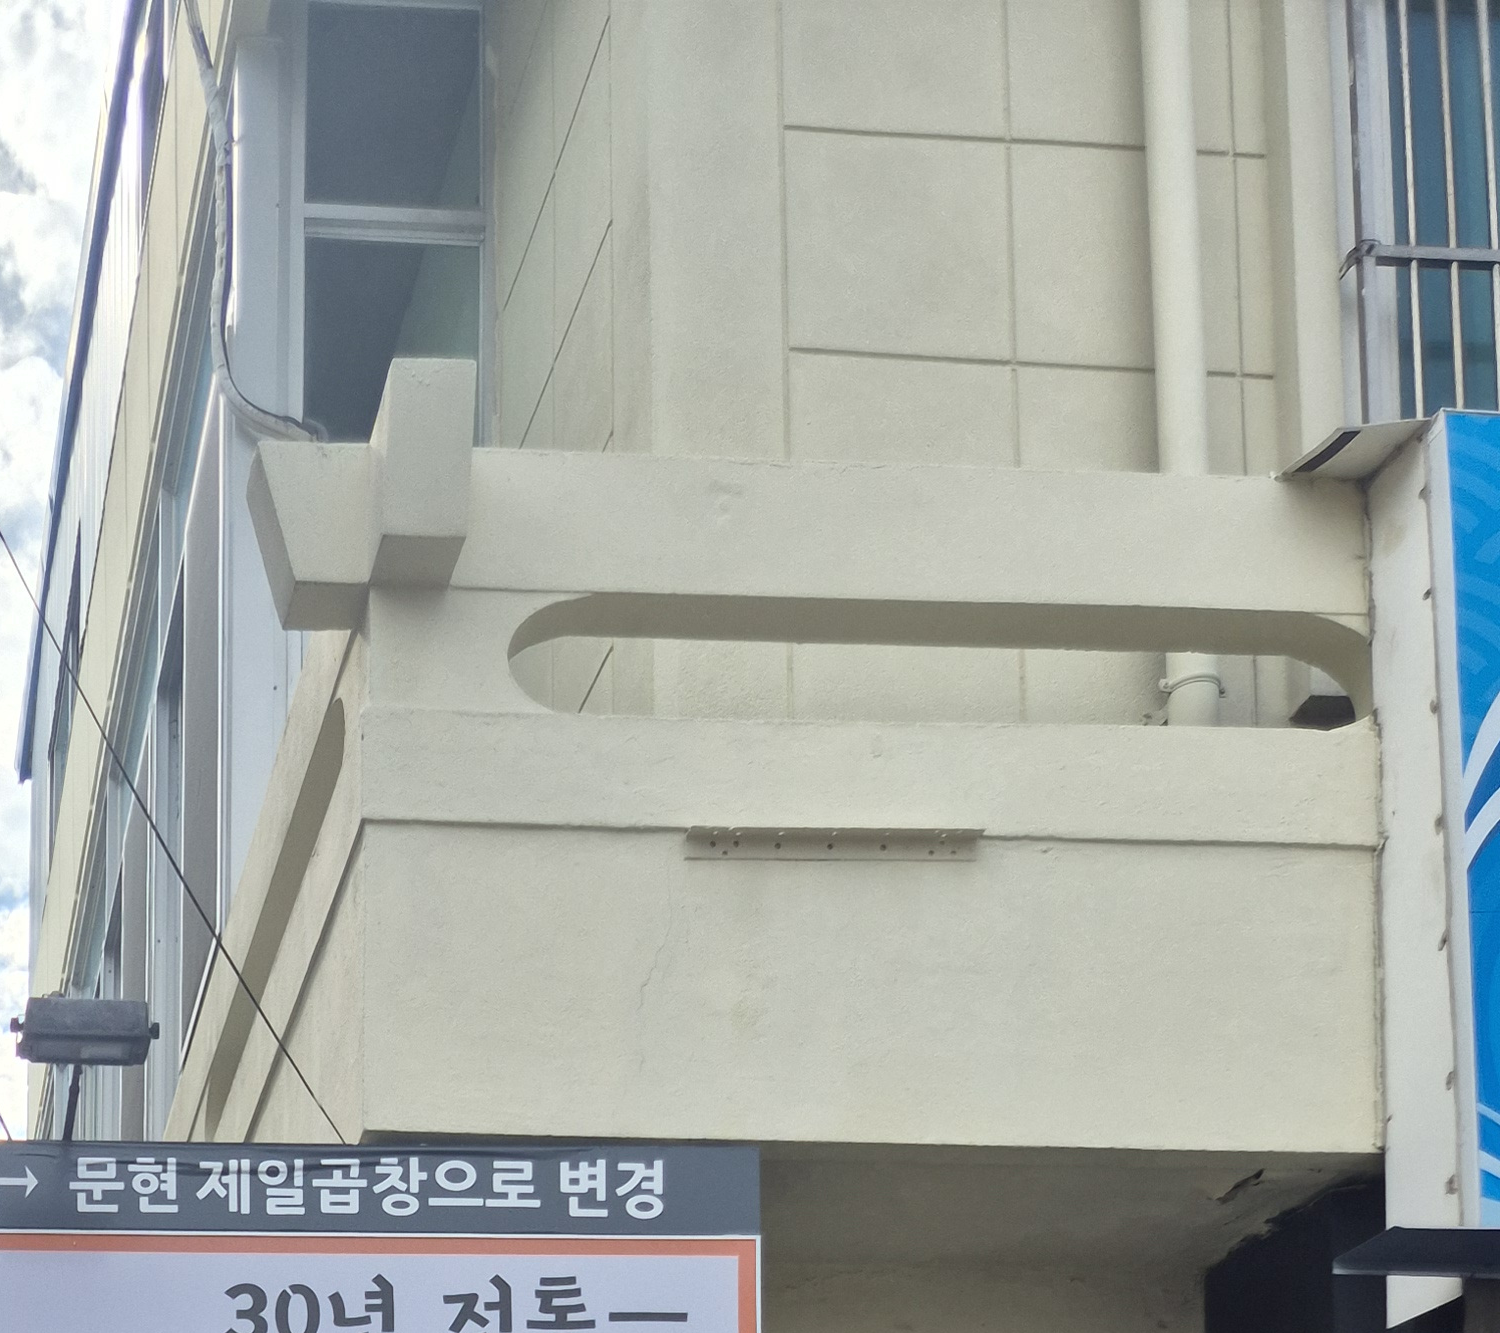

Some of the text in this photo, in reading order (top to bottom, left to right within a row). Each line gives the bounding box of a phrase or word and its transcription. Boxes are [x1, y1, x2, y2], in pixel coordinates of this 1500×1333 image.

[69, 1157, 180, 1214] 문현
[196, 1158, 541, 1218] 제일곱창으로
[559, 1158, 665, 1220] 변경
